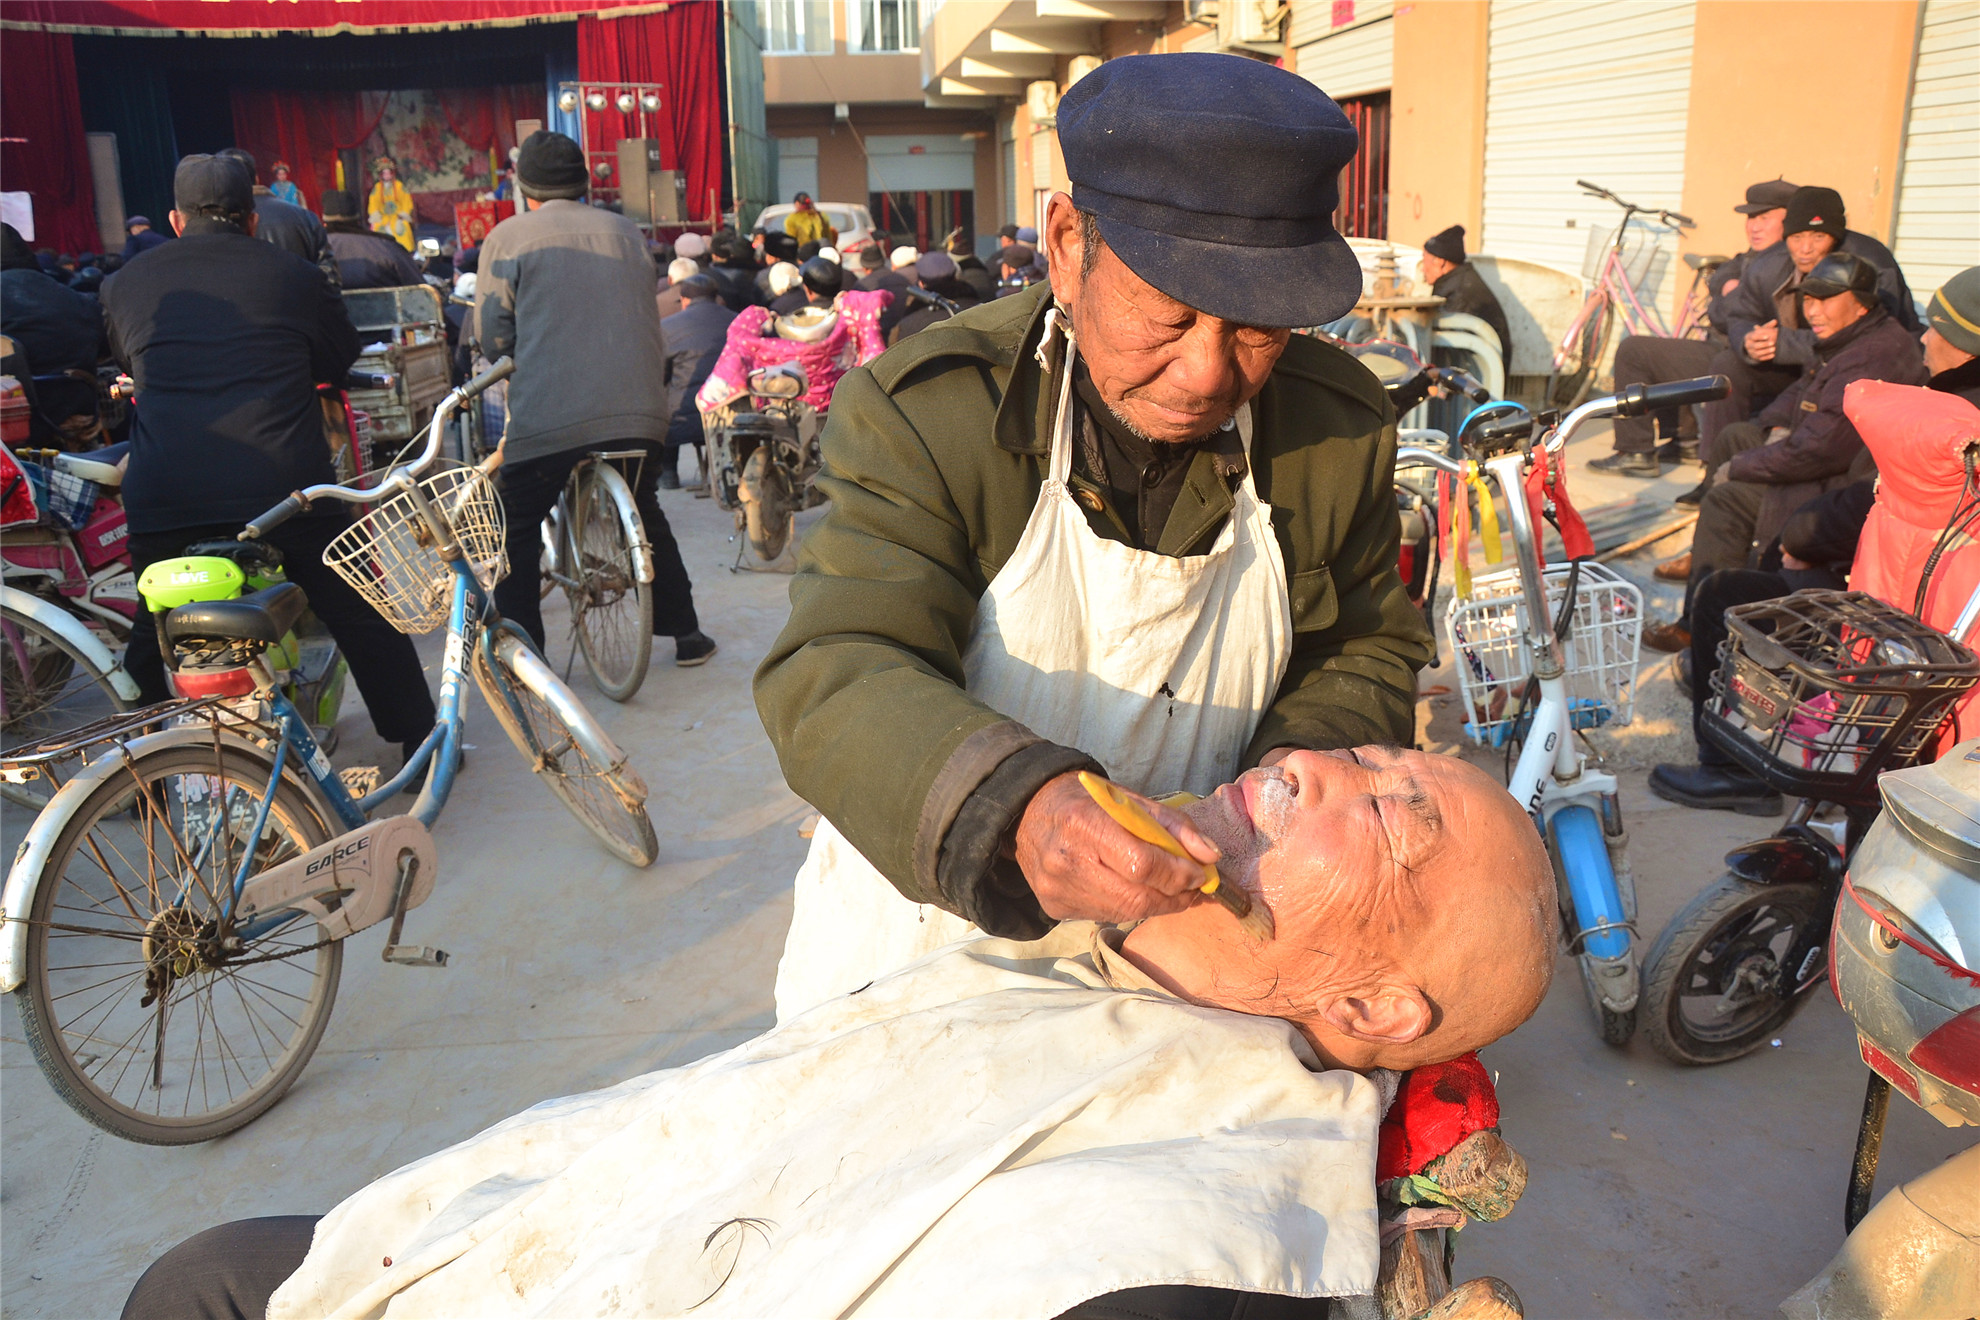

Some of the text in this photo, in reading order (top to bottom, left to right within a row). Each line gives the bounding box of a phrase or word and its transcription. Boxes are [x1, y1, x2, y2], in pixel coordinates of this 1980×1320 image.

[171, 571, 209, 584] LOVE
[461, 589, 476, 677] GARCE
[305, 836, 370, 876] GARCE
